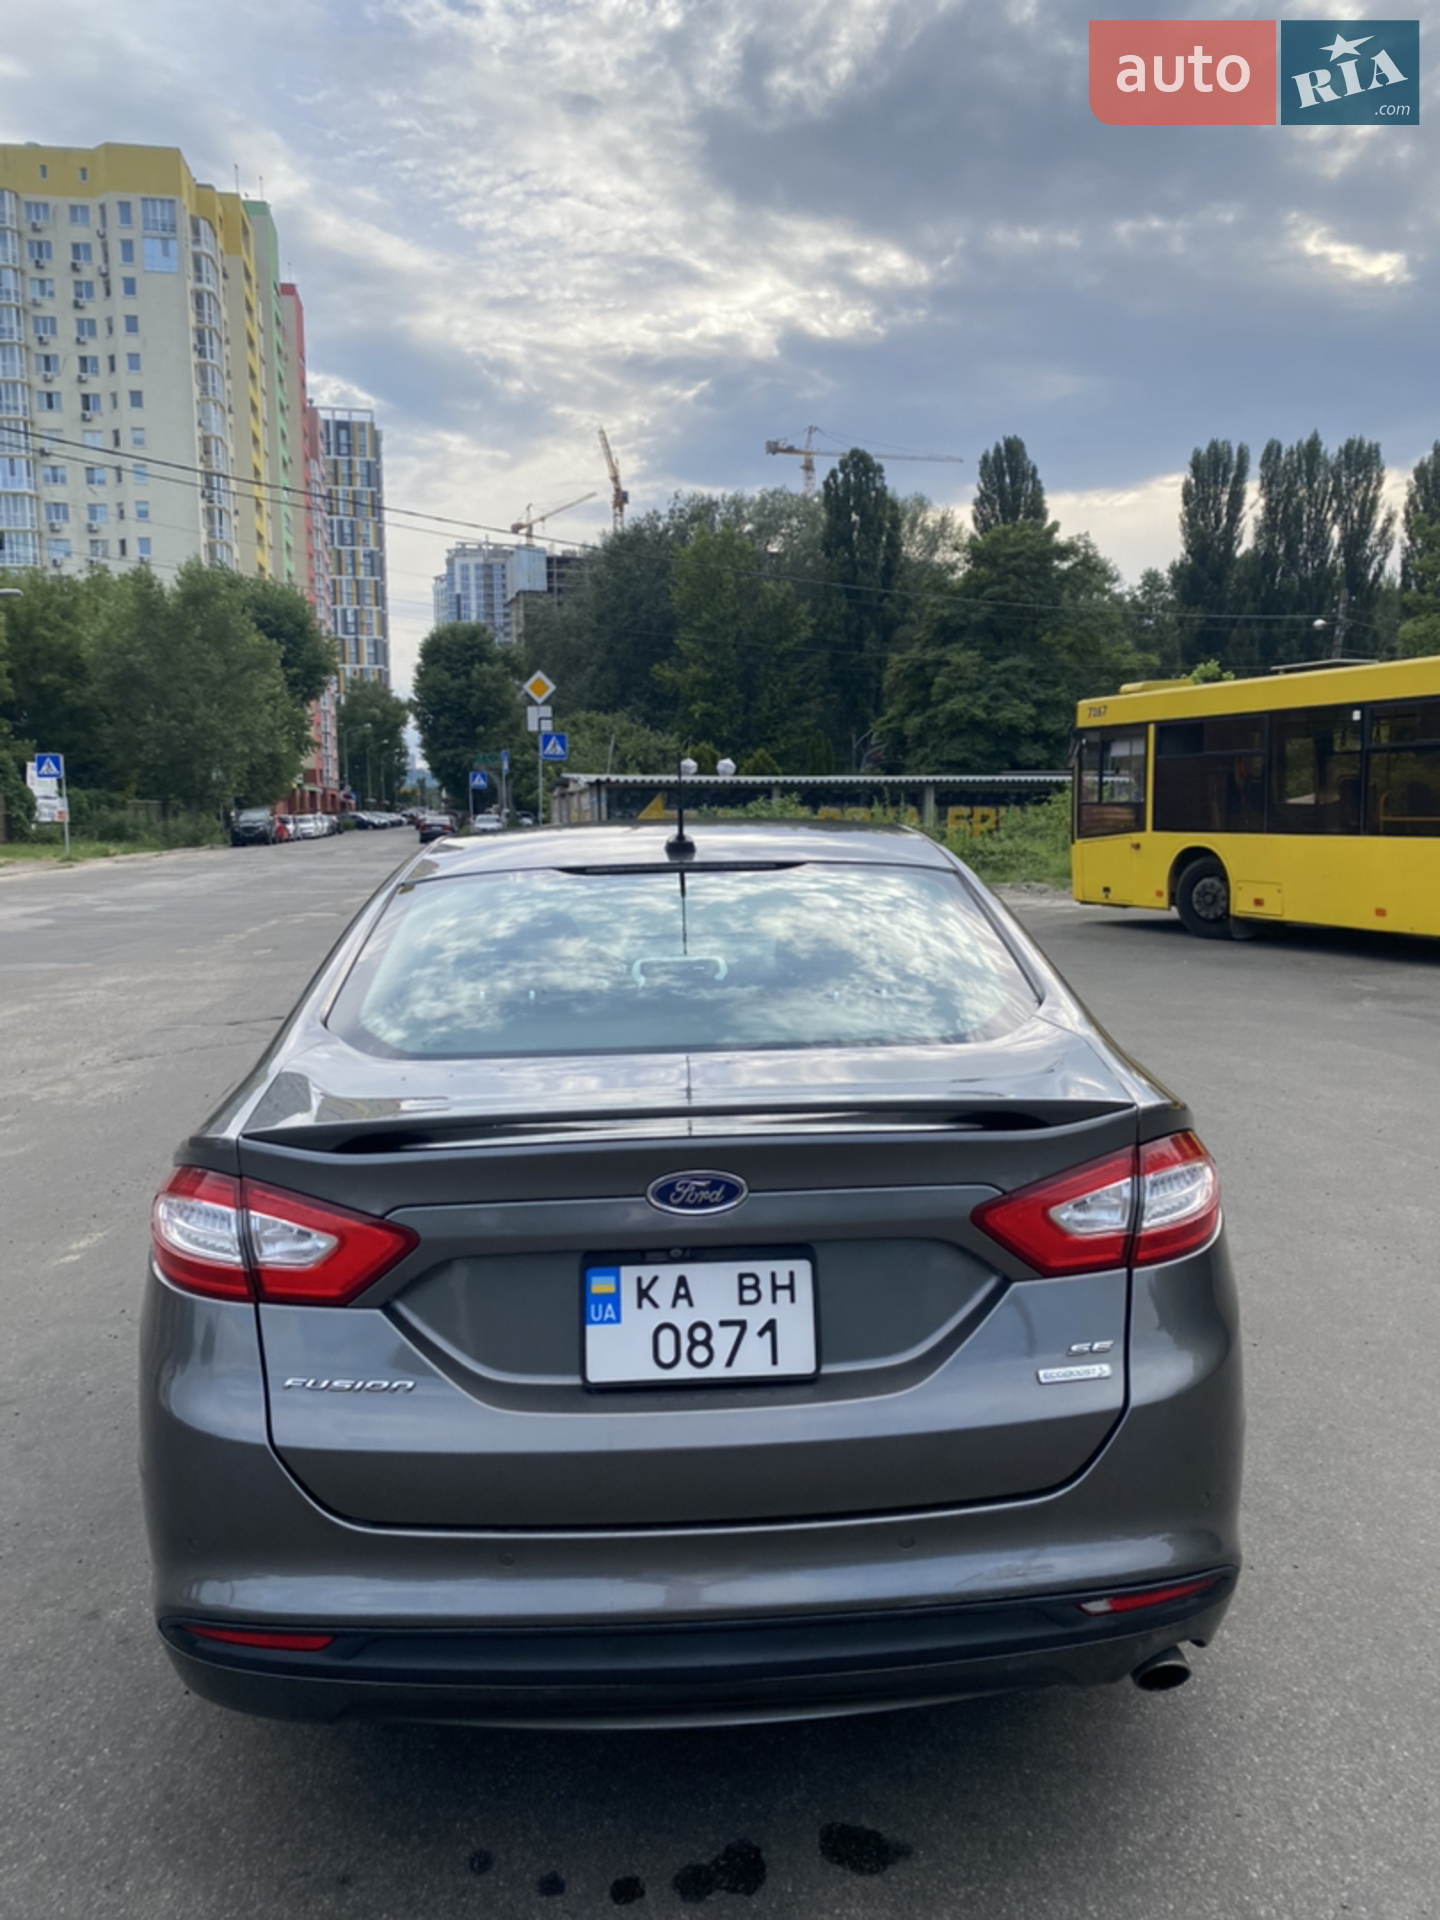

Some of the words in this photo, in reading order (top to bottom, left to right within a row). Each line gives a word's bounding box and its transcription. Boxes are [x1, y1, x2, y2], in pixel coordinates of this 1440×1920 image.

[669, 1179, 725, 1205] Ford
[590, 1303, 616, 1322] UA
[651, 1318, 778, 1370] 0871
[1067, 1340, 1114, 1356] SE
[283, 1377, 416, 1393] FUSION
